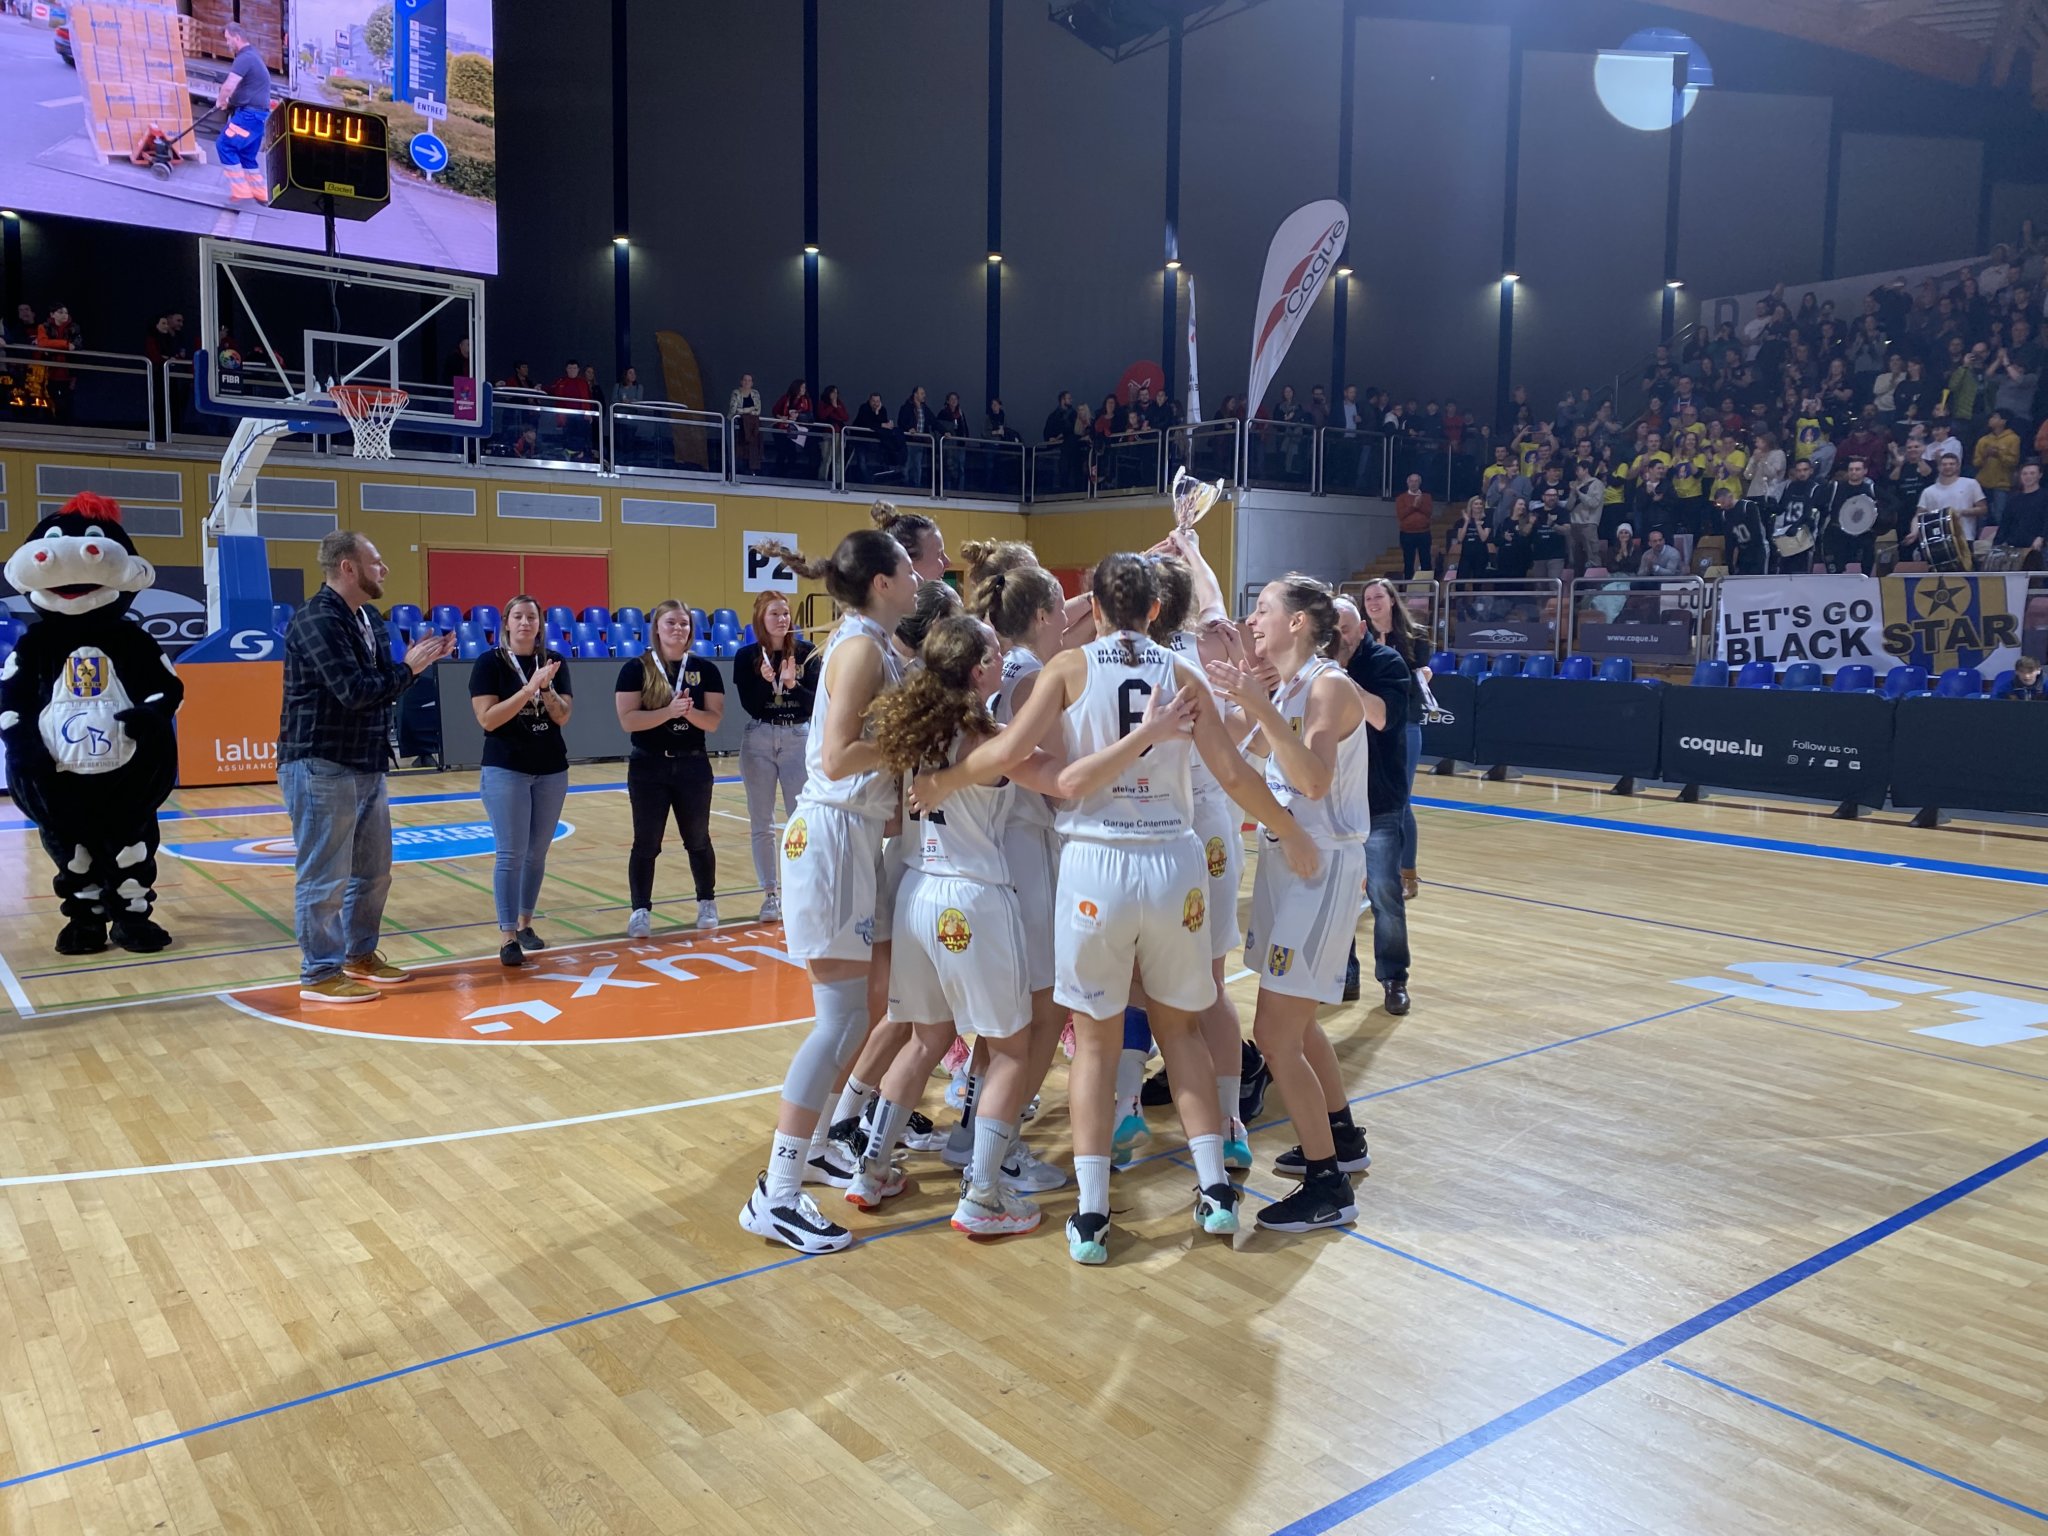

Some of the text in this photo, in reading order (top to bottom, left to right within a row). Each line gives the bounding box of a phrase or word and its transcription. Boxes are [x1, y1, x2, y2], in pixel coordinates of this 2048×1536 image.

[222, 373, 240, 385] FIBA
[1724, 599, 1874, 635] LET'S GO
[1607, 634, 1659, 643] www.coque.lu
[1882, 613, 2022, 657] STAR
[1726, 626, 1873, 666] BLACK
[1680, 735, 1764, 757] coque.lu
[1792, 739, 1858, 755] Follow us on
[1138, 785, 1149, 794] 33
[1103, 818, 1135, 828] Garage
[926, 845, 937, 853] 33
[777, 1145, 798, 1161] 23
